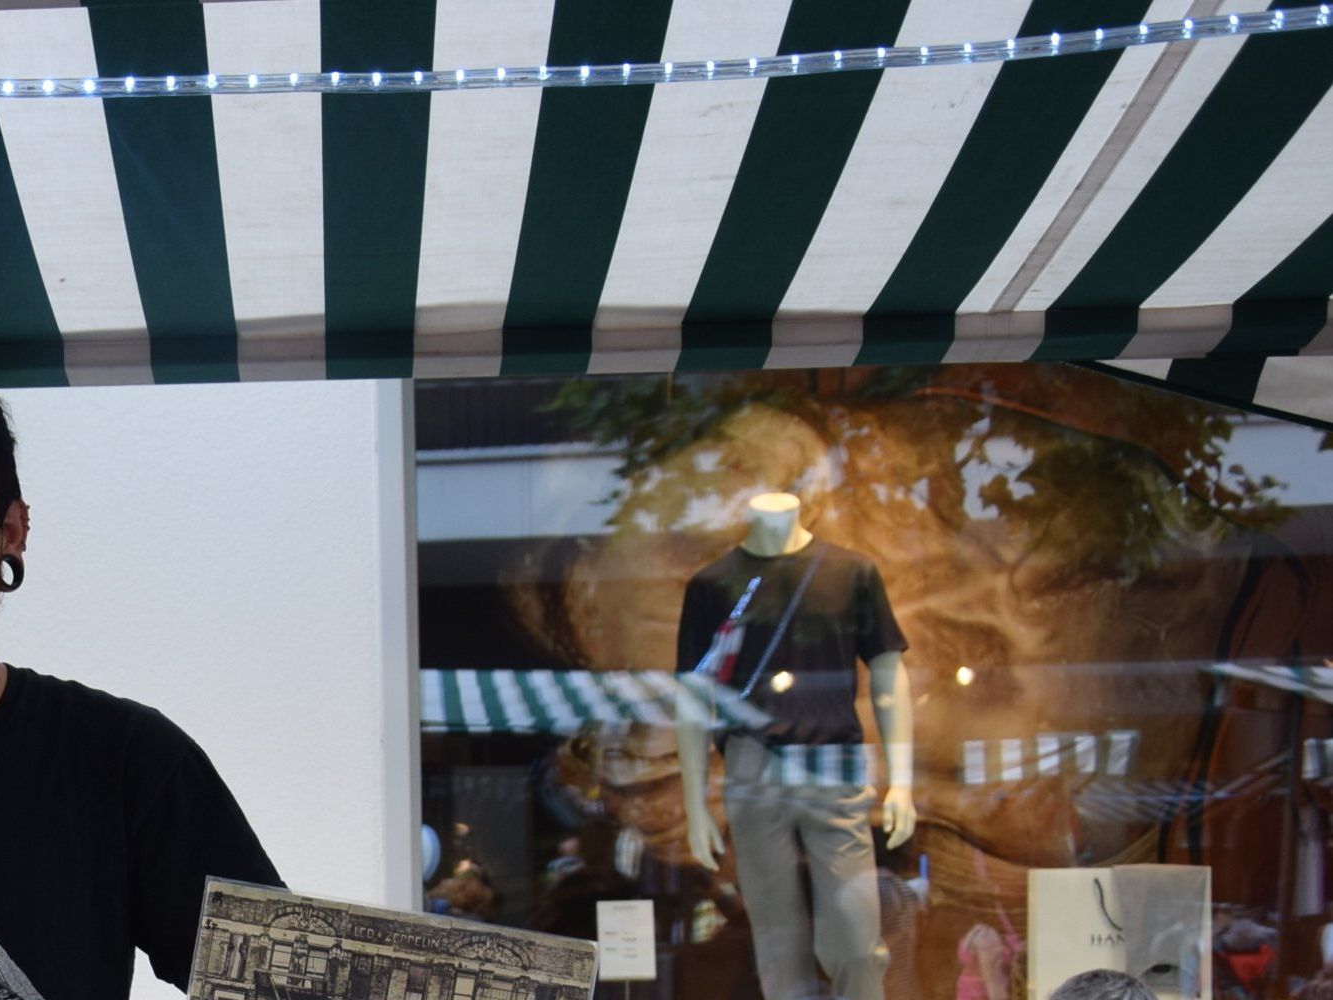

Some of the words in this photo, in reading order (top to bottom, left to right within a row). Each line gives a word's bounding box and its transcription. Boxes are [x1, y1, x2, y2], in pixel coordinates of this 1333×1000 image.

[354, 926, 375, 939] LED
[385, 932, 441, 950] ZEPPELIN
[1090, 933, 1125, 946] HAN
